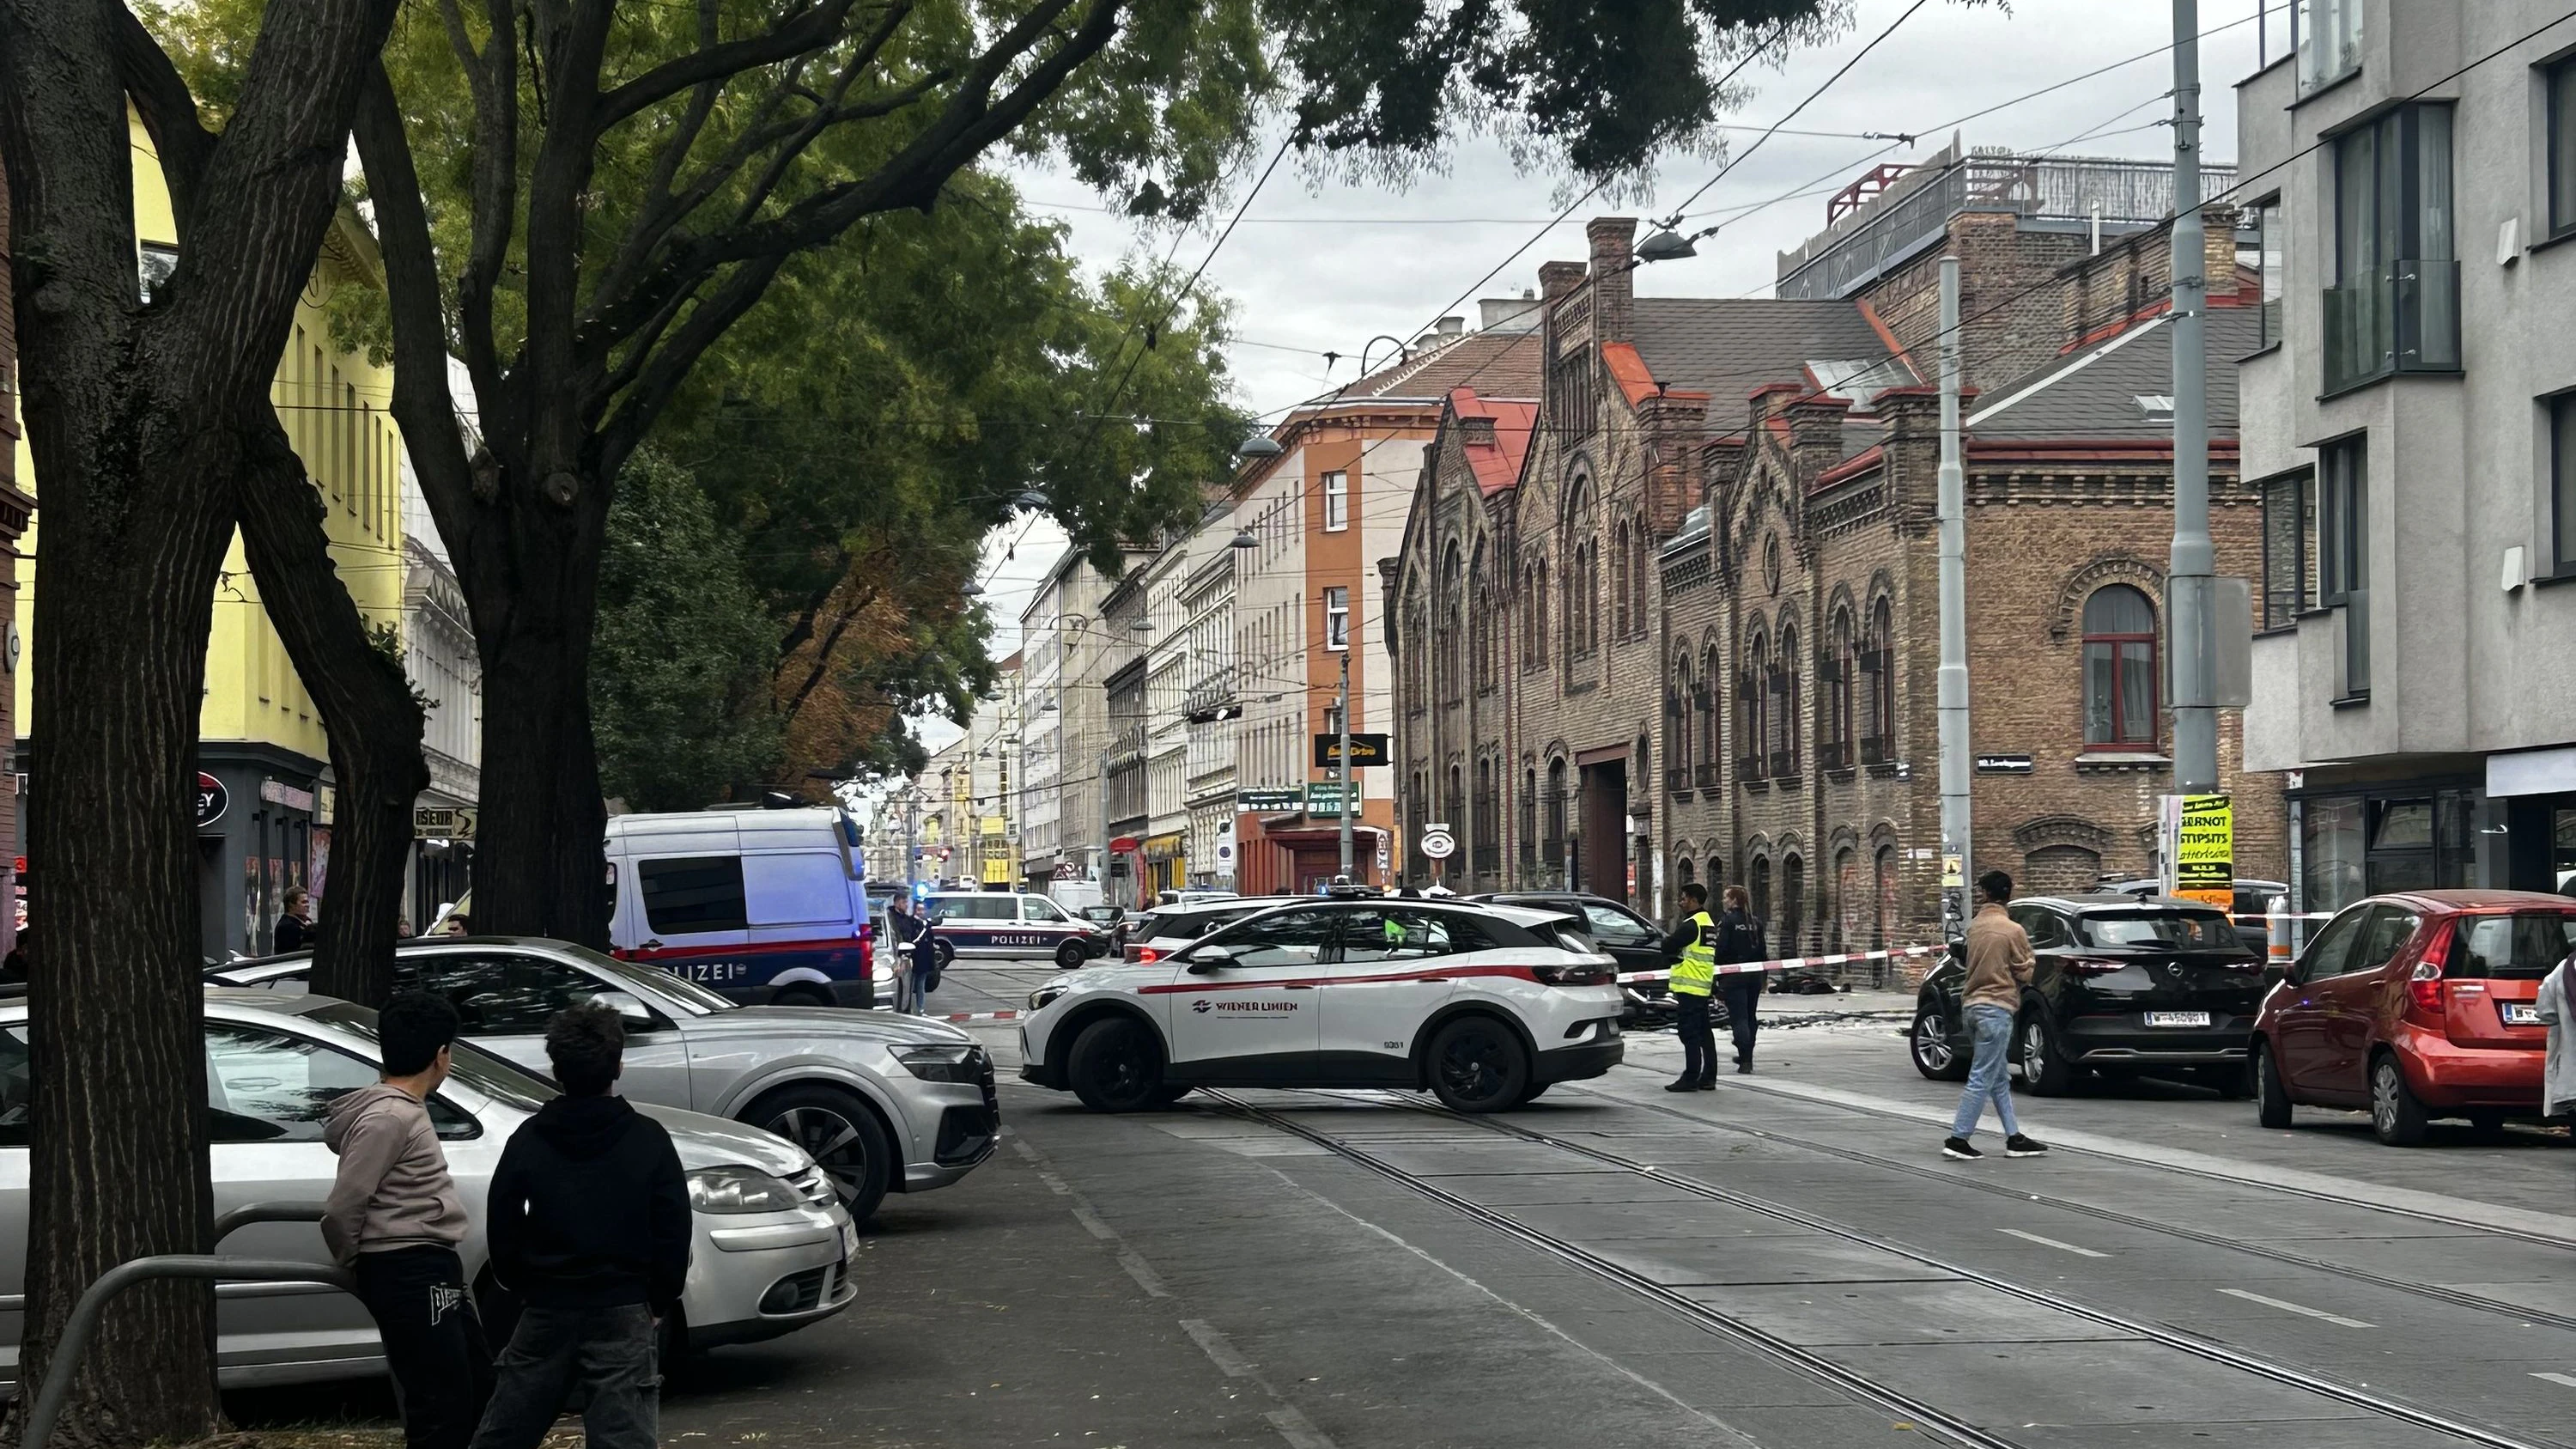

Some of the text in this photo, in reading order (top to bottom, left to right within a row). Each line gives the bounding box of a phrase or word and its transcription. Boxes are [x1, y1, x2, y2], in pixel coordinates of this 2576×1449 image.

[991, 935, 1040, 944] POLIZEI
[674, 964, 733, 981] IZEI
[1216, 1002, 1297, 1011] WIENER LINIEN
